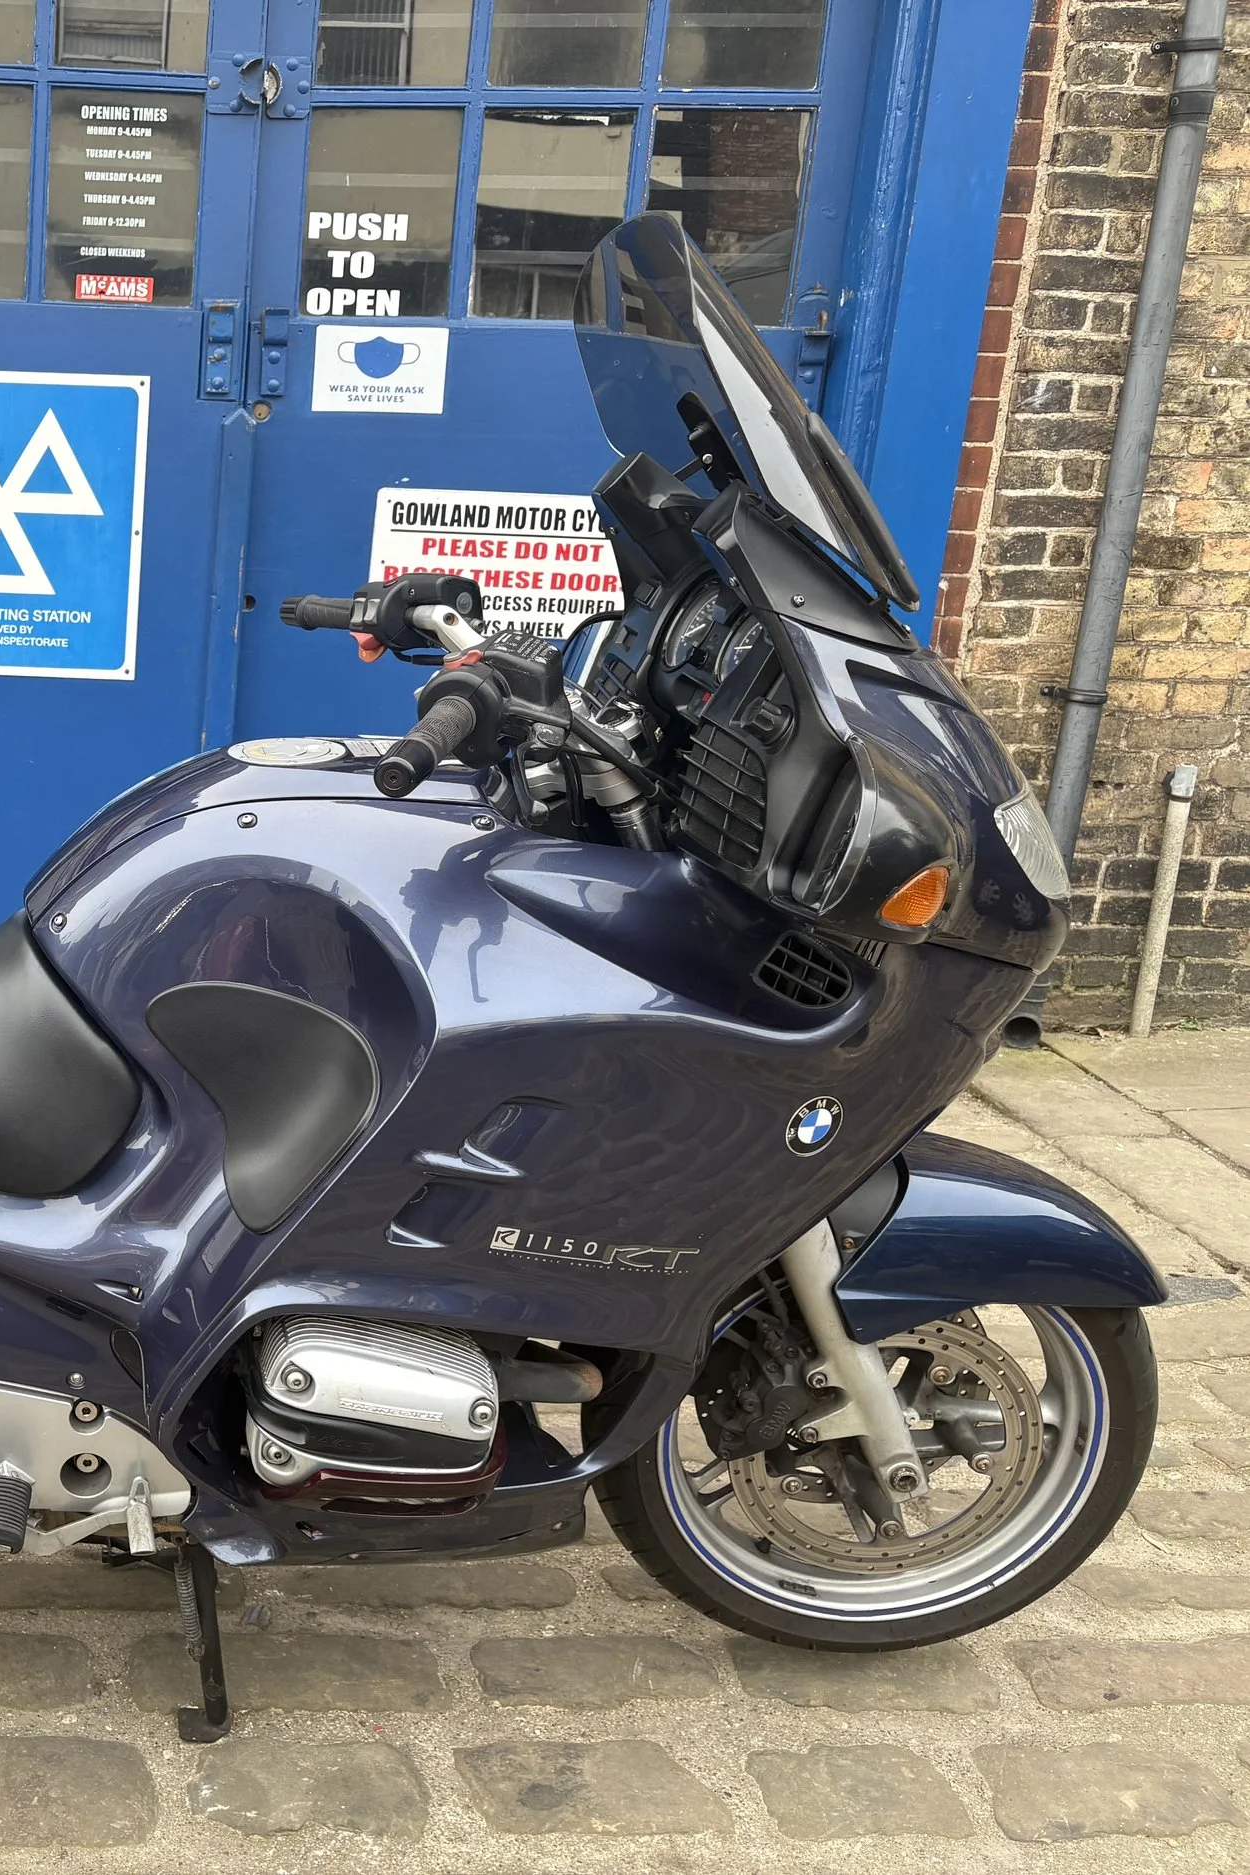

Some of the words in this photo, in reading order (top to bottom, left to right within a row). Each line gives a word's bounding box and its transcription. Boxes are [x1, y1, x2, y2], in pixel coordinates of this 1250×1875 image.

[81, 105, 130, 121] OPENING
[132, 107, 168, 122] TIMES
[86, 125, 117, 136] MONDAY
[85, 148, 117, 159] TUESDAY
[84, 171, 127, 181] WEDNESDAY
[83, 193, 120, 204] THURSDAY
[82, 216, 107, 226] FRIDAY
[307, 211, 409, 242] PUSH
[80, 246, 107, 256] CLOSED
[107, 247, 146, 258] WEEKENDS
[327, 250, 376, 279] TO
[306, 287, 401, 317] OPEN
[329, 384, 359, 393] WEAR
[362, 385, 391, 393] YOUR
[394, 386, 425, 394] MASK
[347, 394, 373, 402] SAVE
[376, 395, 405, 403] LIVES
[391, 501, 491, 530] GOWLAND
[495, 506, 566, 531] MOTOR
[421, 537, 507, 559] PLEASE
[514, 541, 548, 560] DO
[554, 543, 605, 562] NOT
[469, 568, 544, 590] THESE
[550, 572, 623, 592] DOOR
[481, 594, 533, 612] CCESS
[537, 597, 615, 615] REQUIRED
[32, 609, 92, 624] STATION
[19, 624, 34, 634] BY
[525, 1233, 599, 1256] 1150
